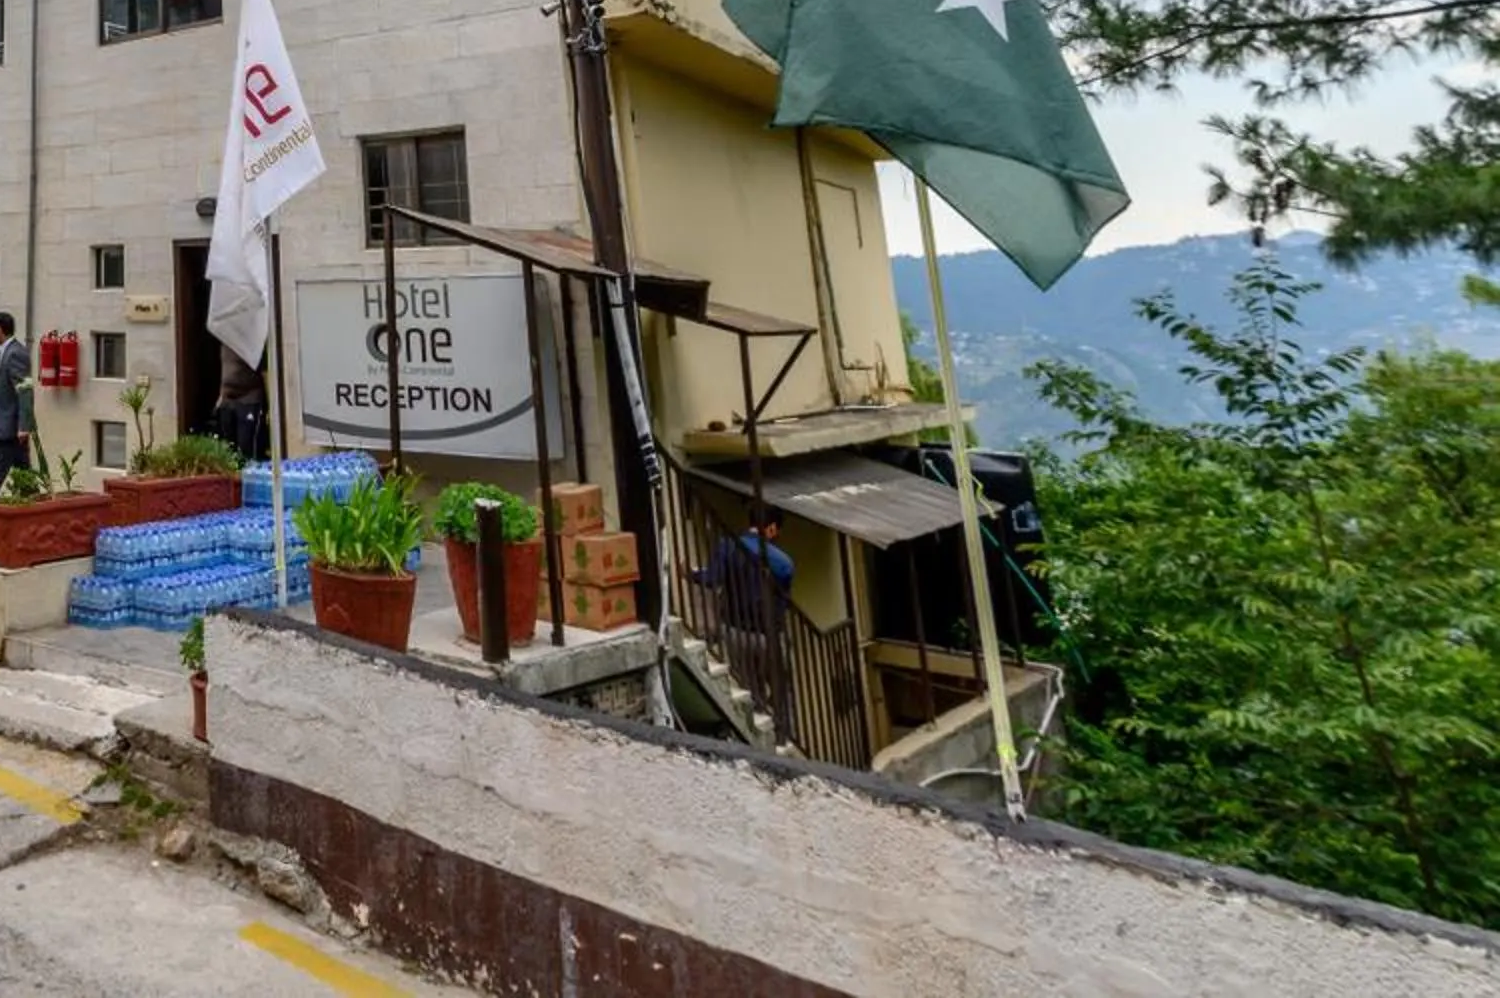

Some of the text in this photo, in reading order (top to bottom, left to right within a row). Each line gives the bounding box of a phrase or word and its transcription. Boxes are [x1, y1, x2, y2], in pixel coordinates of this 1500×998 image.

[363, 283, 451, 319] Hotel
[365, 323, 453, 364] One
[335, 382, 493, 413] RECEPTION
